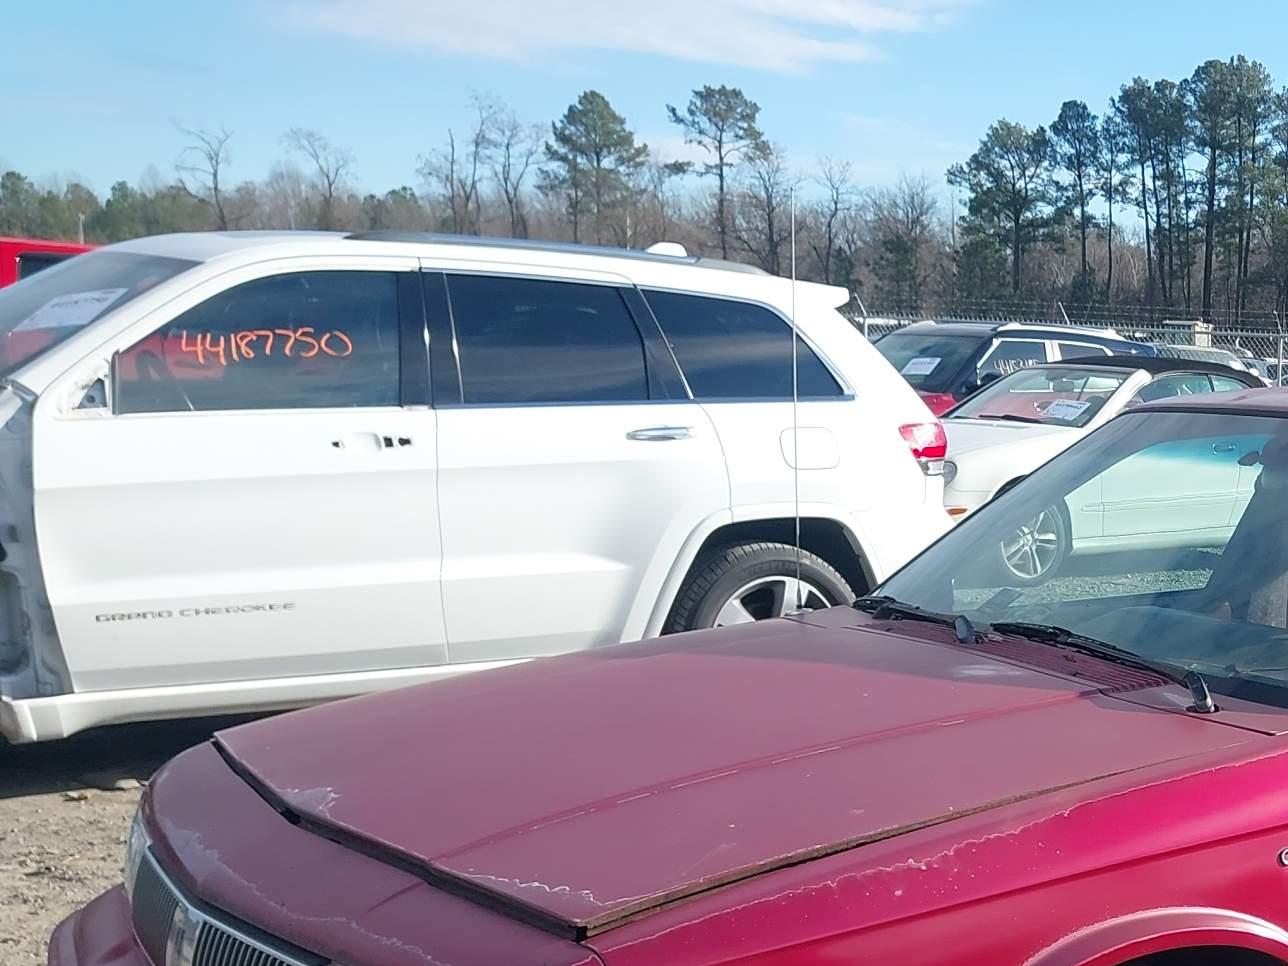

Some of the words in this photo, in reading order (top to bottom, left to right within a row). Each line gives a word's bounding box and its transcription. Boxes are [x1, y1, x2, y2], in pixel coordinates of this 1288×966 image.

[180, 327, 353, 367] 44187750
[95, 609, 173, 622] GRAND
[179, 603, 296, 618] CHEROKEE
